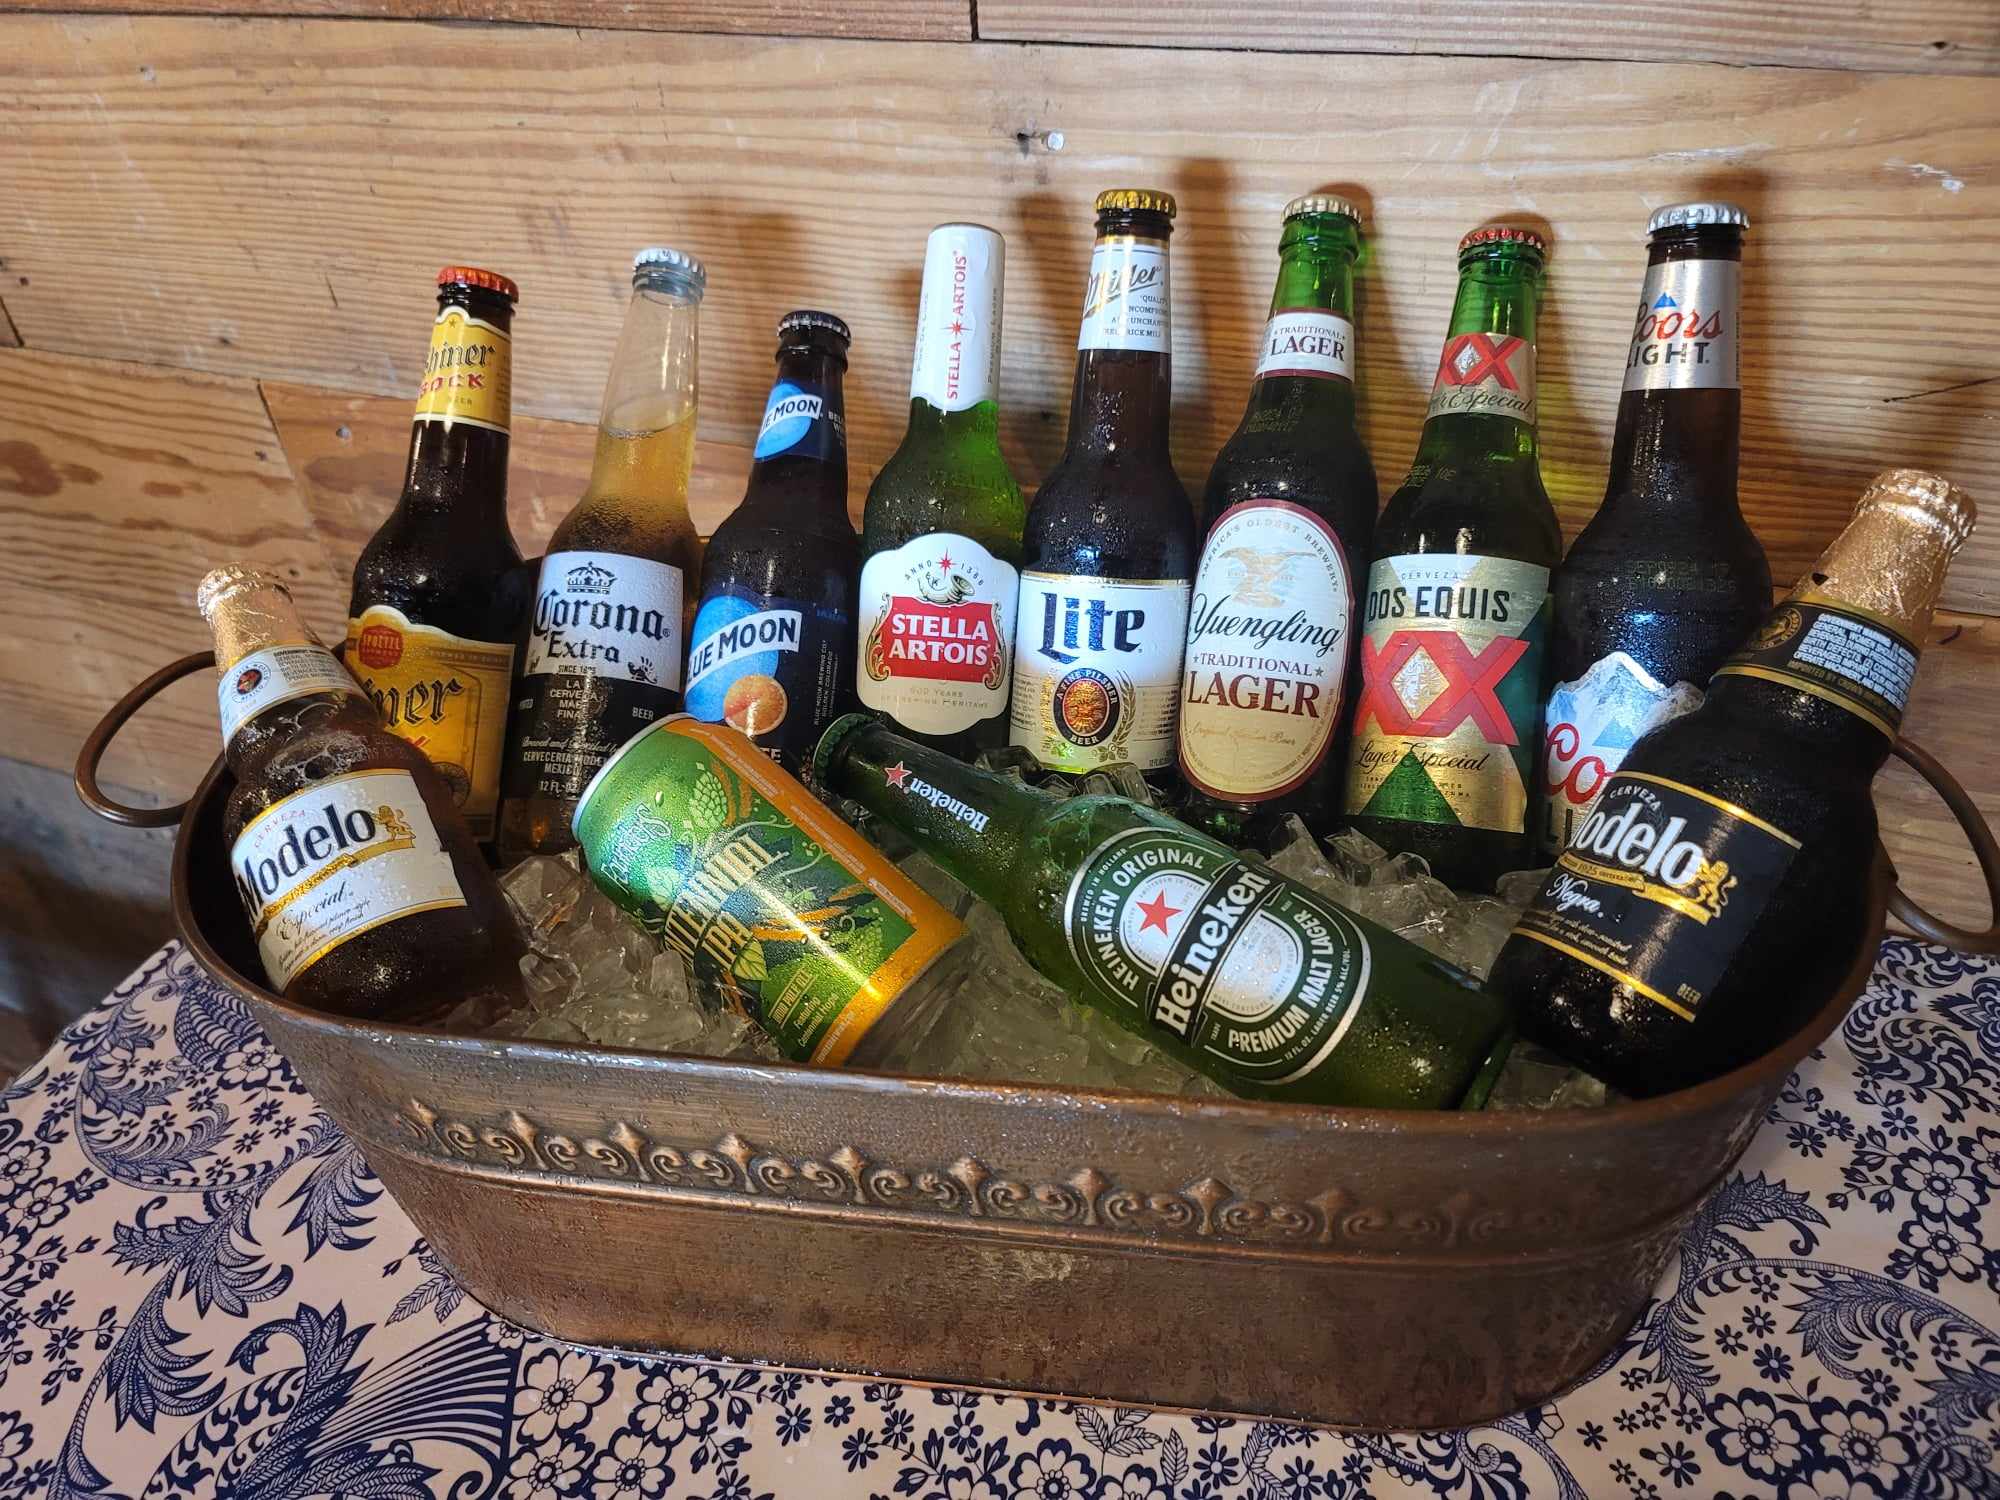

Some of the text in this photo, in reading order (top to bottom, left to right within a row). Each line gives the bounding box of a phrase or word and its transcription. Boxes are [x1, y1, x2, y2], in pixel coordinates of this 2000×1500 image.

[947, 256, 967, 399] STELLA ARTOIS
[1280, 326, 1340, 341] TRADITIONAL
[1270, 335, 1345, 362] LAGER
[773, 400, 819, 422] MOON
[1449, 384, 1531, 412] Especial
[905, 560, 932, 580] ANNO
[1304, 533, 1339, 588] BREWERY
[1401, 572, 1459, 580] CERVEZA
[533, 590, 665, 642] Corona
[1368, 587, 1511, 622] DOS EQUIS
[891, 613, 989, 641] STELLA
[1037, 592, 1145, 665] Lite
[1188, 593, 1347, 658] Yuengling
[544, 630, 620, 664] Extra
[687, 617, 797, 683] LUE MOON
[889, 639, 988, 665] ARTOIS
[1200, 652, 1313, 677] TRADITIONAL
[558, 665, 577, 673] SINCE
[566, 680, 580, 688] LA
[1085, 670, 1119, 704] PILSNER
[1187, 670, 1320, 718] LAGER
[632, 707, 654, 720] BEER
[1070, 735, 1100, 745] BEER
[1355, 741, 1398, 774] Lager
[1402, 742, 1491, 773] Especial
[540, 780, 548, 791] 12
[1610, 785, 1661, 812] CERVEZA
[910, 777, 990, 833] Heineken
[254, 809, 306, 848] CERVEZA
[1570, 802, 1705, 888] odelo
[1091, 876, 1101, 887] IN
[1098, 848, 1127, 875] HOLLAND
[1112, 848, 1204, 887] ORIGINAL
[1546, 872, 1601, 912] Negra
[277, 880, 347, 941] Especial
[702, 910, 754, 973] IPA
[1094, 889, 1140, 991] HEINEKEN
[1293, 909, 1334, 955] LAGER
[1155, 869, 1271, 1035] Heineken
[1298, 958, 1333, 1008] MALT
[1677, 983, 1700, 1005] BEER
[793, 996, 821, 1029] Featuring
[798, 1011, 824, 1047] Centennial
[1228, 1004, 1310, 1053] PREMIUM
[1284, 1050, 1293, 1060] 12
[1311, 1011, 1329, 1036] LAGER
[1326, 992, 1340, 1013] BEER
